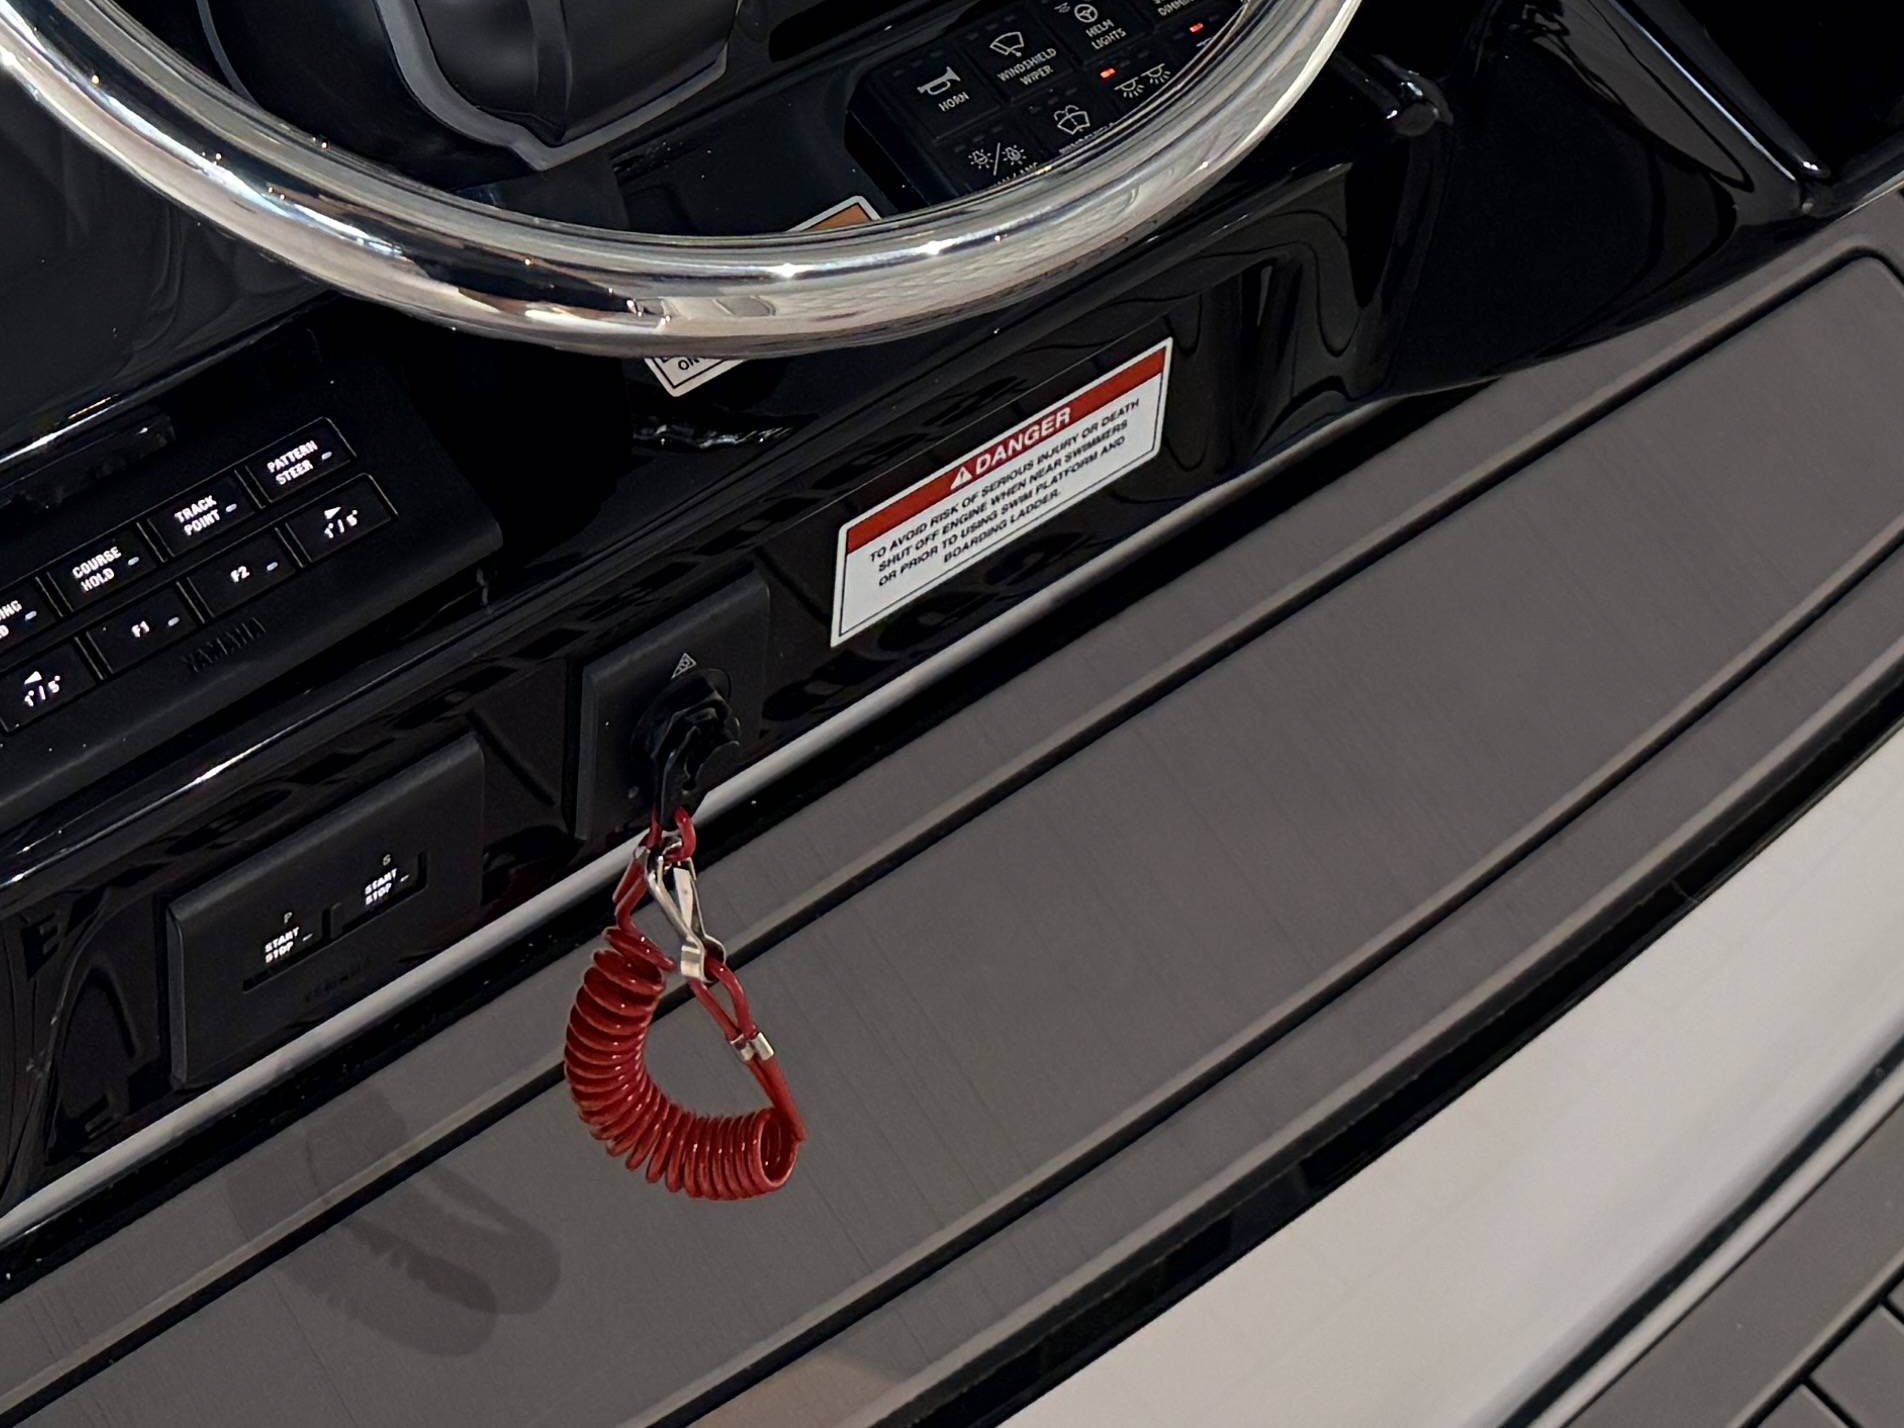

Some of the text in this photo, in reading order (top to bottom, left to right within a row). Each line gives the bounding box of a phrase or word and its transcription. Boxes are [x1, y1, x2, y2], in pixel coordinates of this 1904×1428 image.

[1086, 19, 1115, 38] HELM
[1091, 27, 1127, 50] LIGHTS
[997, 47, 1057, 82] WINDSHIELD
[1019, 65, 1054, 86] WIPER
[938, 92, 969, 112] HORN
[975, 406, 1072, 475] DANGER
[266, 440, 319, 473] PATTERN
[275, 459, 314, 485] STEER
[870, 398, 1139, 562] TO AVOID RISK OF SERIOUS INJURY OR DEATH
[879, 420, 1128, 572] SHUT OFF ENGINE WHEN NEAR SWIMMERS
[174, 495, 217, 524] TRACK
[183, 509, 221, 536] POINT
[878, 436, 1125, 586] OR PRIOR TO USING SWIM PLATFORM AND
[944, 520, 1007, 563] BOARDING
[72, 545, 122, 579] COURSE
[230, 566, 250, 583] F2
[81, 568, 115, 592] HOLD
[130, 620, 150, 638] F1
[364, 868, 398, 894] START
[364, 883, 392, 906] STOP
[264, 926, 299, 953] START
[264, 941, 294, 964] STOP
